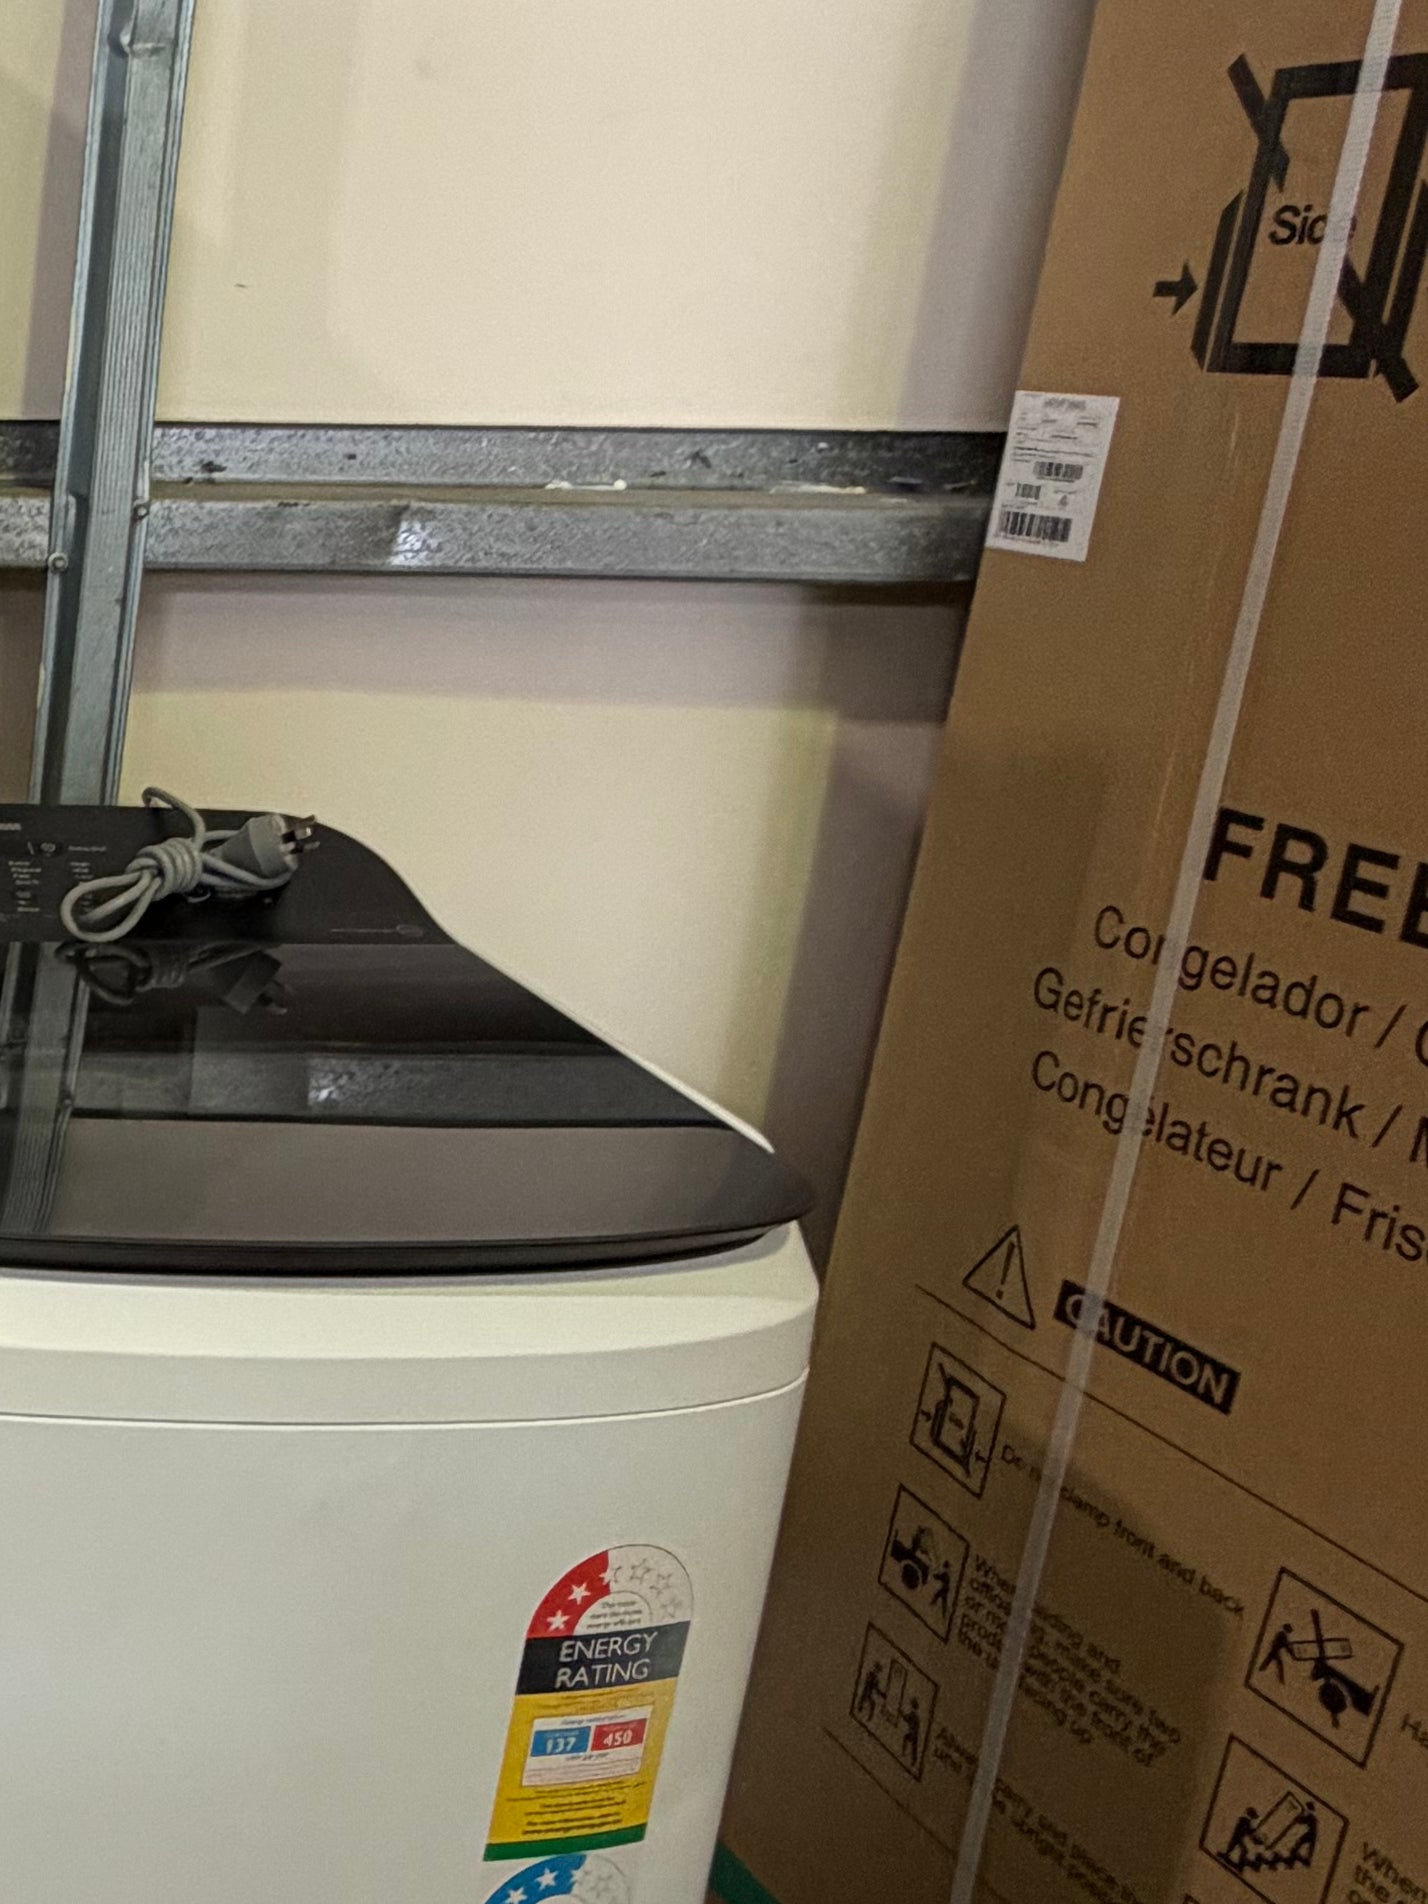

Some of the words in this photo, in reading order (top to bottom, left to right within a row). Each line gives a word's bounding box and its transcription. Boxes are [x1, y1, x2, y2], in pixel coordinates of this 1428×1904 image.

[1331, 1181, 1428, 1262] Fris
[559, 1631, 658, 1663] ENERGY
[555, 1659, 650, 1689] RATING
